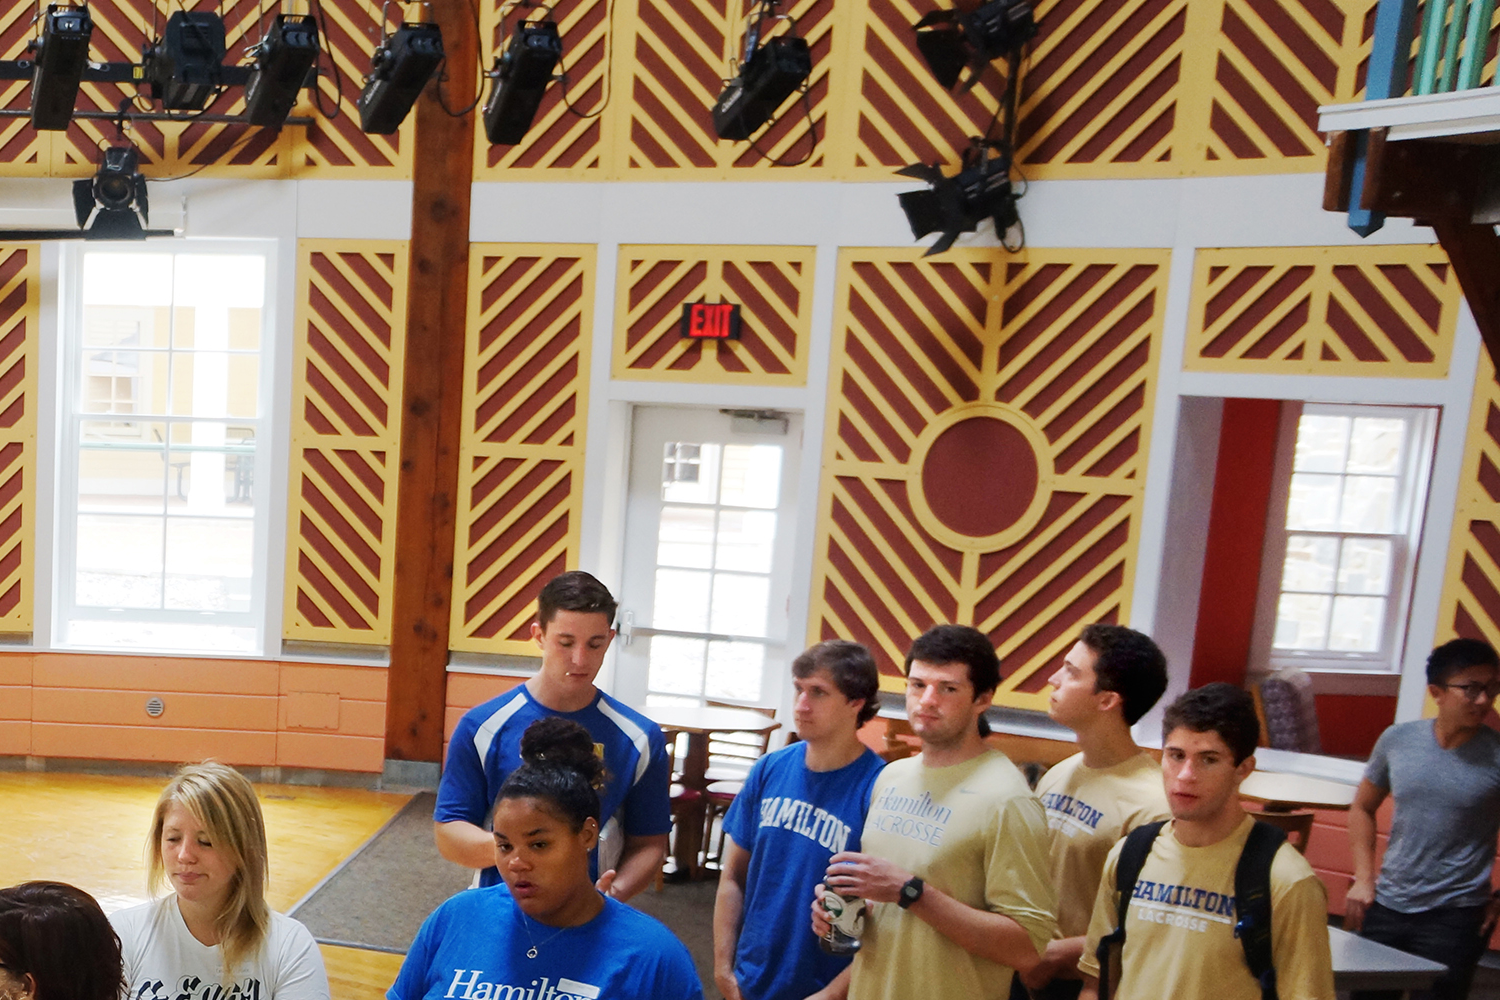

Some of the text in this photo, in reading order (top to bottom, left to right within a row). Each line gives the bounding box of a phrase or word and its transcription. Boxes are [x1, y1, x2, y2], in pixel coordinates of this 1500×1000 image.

[689, 304, 733, 337] EXIT
[875, 787, 951, 825] Hamilton
[1132, 880, 1236, 917] HAMILTON
[1137, 909, 1208, 933] LACROSSE
